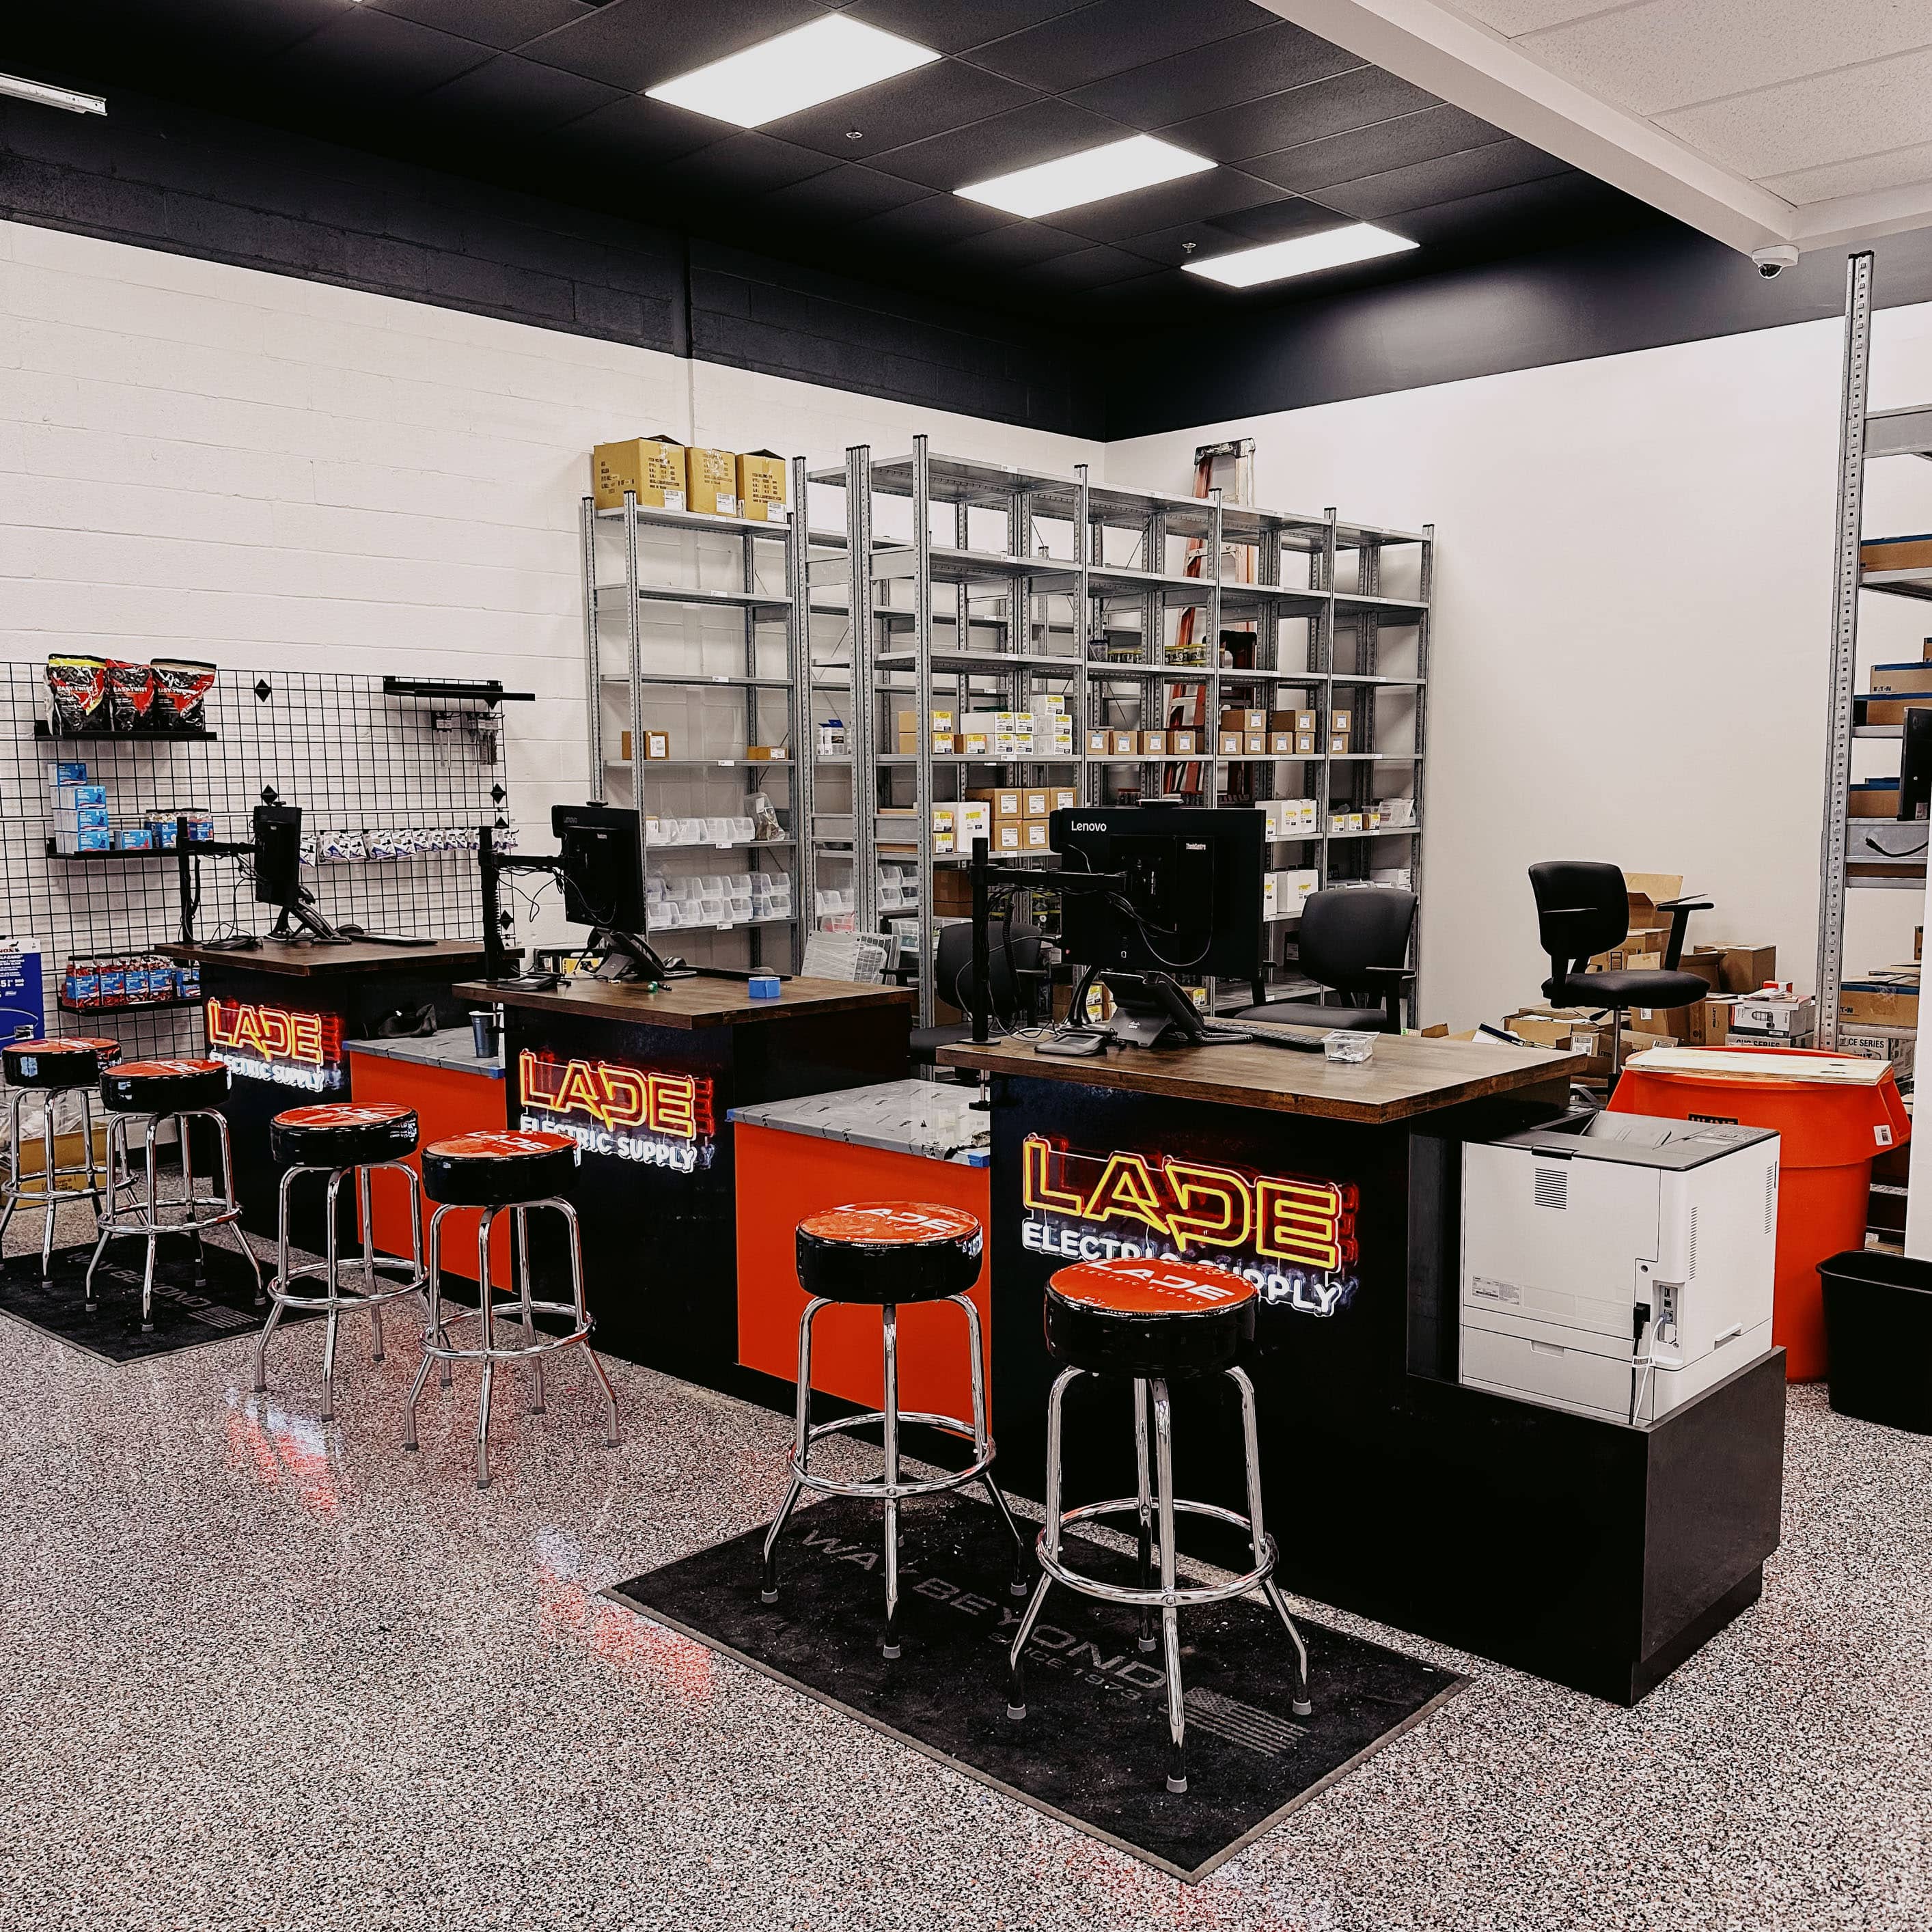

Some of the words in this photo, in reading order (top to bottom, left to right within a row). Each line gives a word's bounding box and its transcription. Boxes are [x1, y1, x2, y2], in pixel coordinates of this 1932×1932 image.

[1071, 820, 1107, 832] Lenovo
[208, 1002, 322, 1064] LADE
[1859, 1038, 1884, 1049] SERIES
[273, 1064, 325, 1092] SUPPLY
[519, 1054, 694, 1137] LADE
[465, 1131, 552, 1151] LADE
[616, 1135, 698, 1173] SUPPLY
[833, 1204, 961, 1230] LADE
[1025, 1140, 1337, 1269] LADE
[109, 1269, 212, 1308] BEOND
[1071, 1267, 1140, 1286] ELECTRIC
[1147, 1285, 1204, 1305] SUPPLY
[1086, 1260, 1236, 1301] LADE
[912, 1577, 1167, 1689] BEYOND
